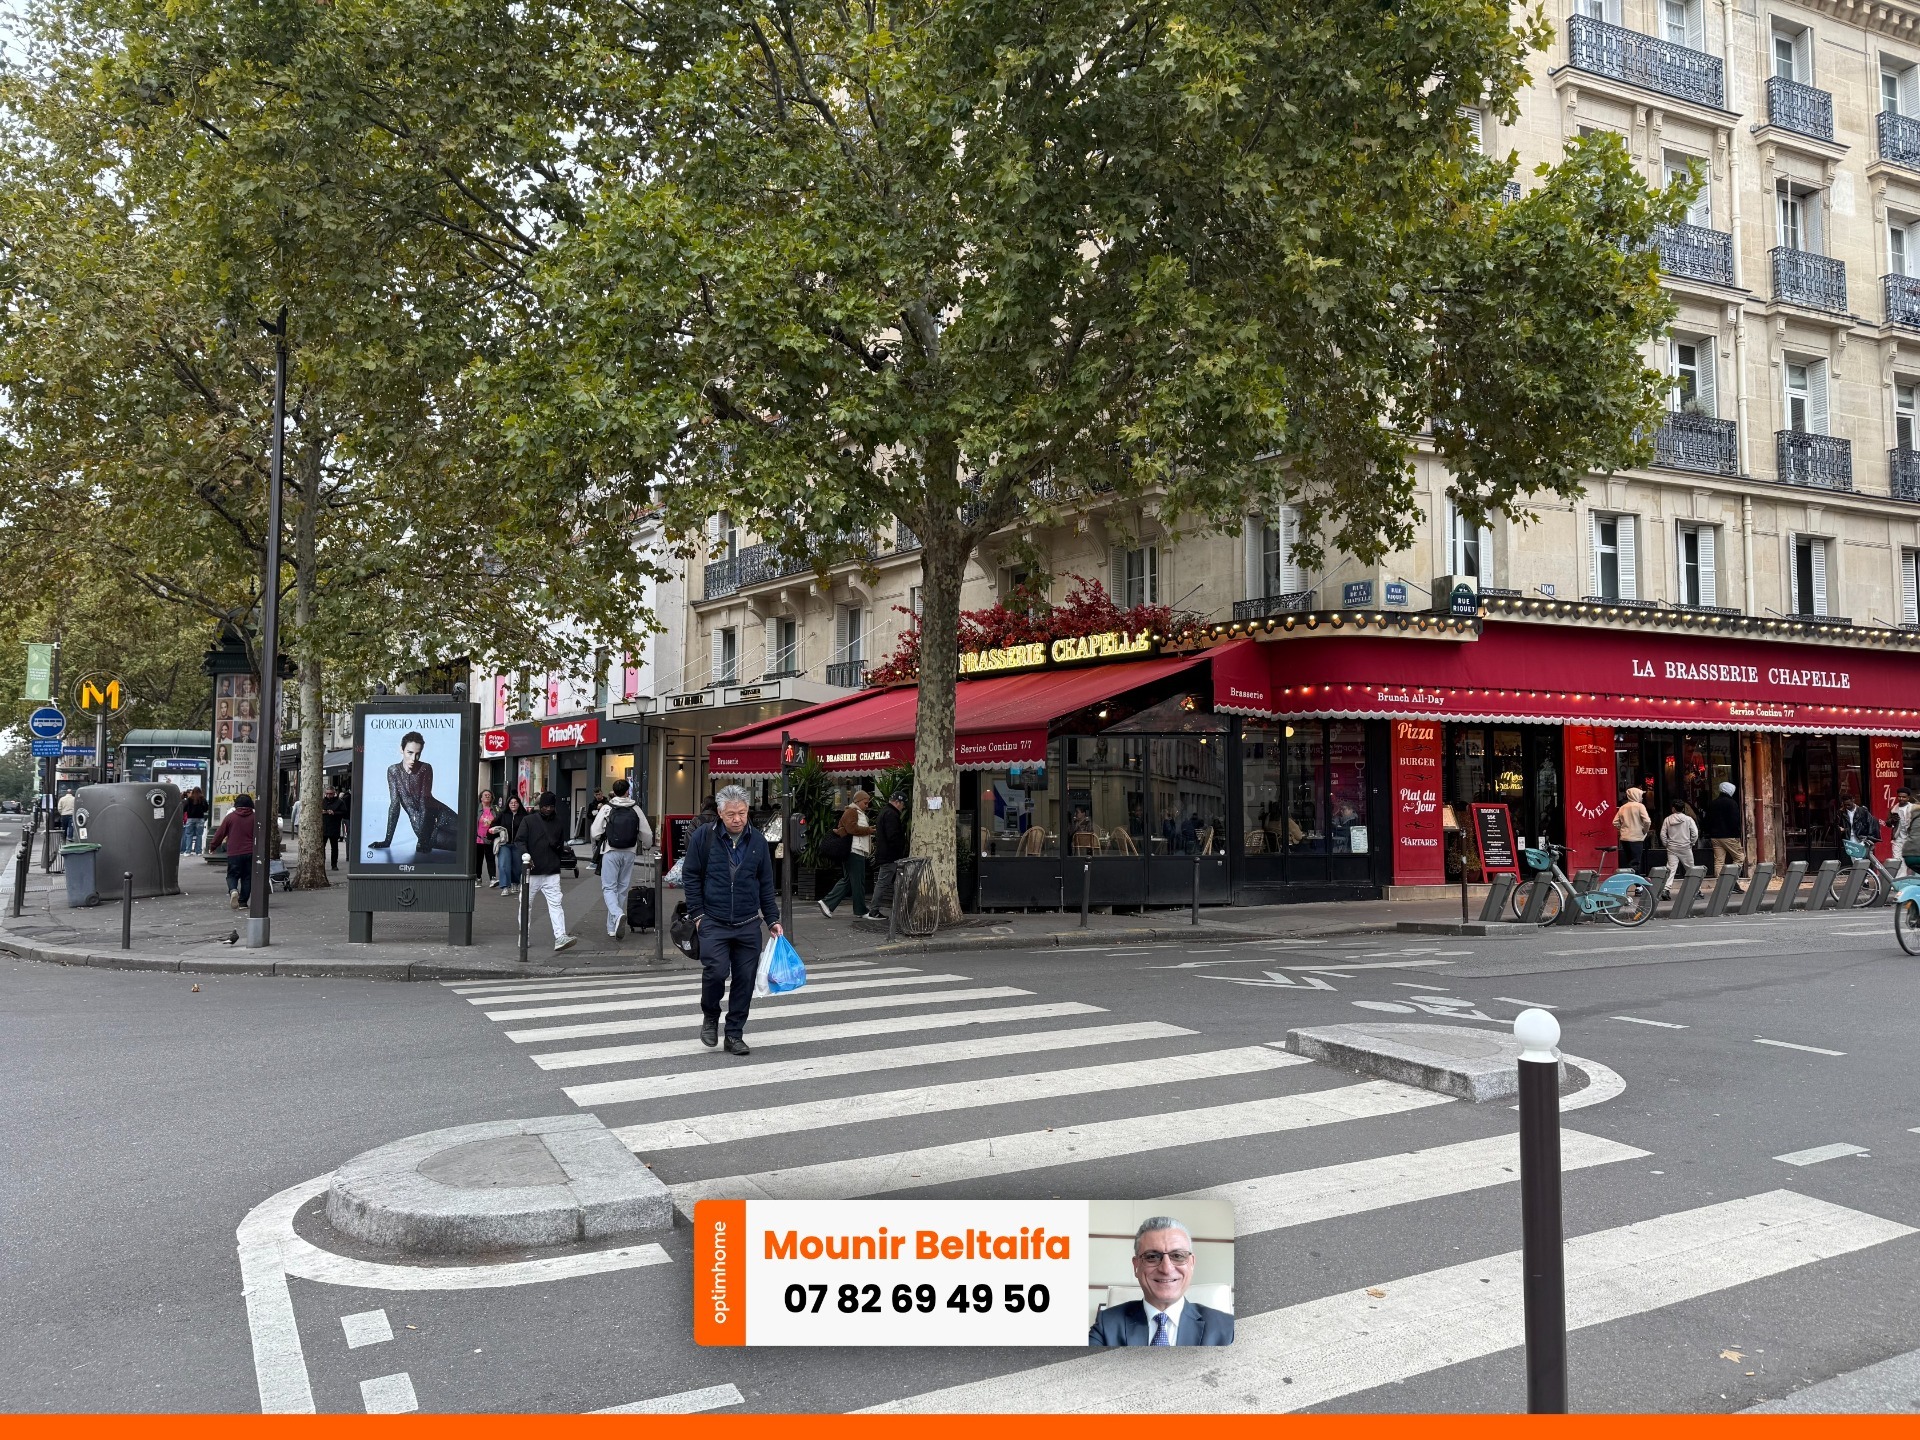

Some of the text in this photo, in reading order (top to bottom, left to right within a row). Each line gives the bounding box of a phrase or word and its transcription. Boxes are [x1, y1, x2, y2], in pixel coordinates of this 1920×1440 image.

[1541, 584, 1554, 595] 100
[1344, 595, 1372, 604] CHAPELLE
[1457, 597, 1470, 605] RUE
[1453, 605, 1475, 613] RIQUET
[958, 630, 1151, 674] BRASSERIE CHAPELLE
[1631, 659, 1850, 689] LA BRASSERIE CHAPELLE
[82, 679, 119, 710] M
[1230, 686, 1264, 700] Brasserie
[1377, 692, 1445, 706] Brunch All-Day
[1729, 706, 1795, 718] Service Continu 7/7
[371, 718, 454, 730] GIORGIO ARMANI
[1397, 722, 1434, 740] Pizza
[960, 740, 1032, 754] Service Continu 7/7
[717, 756, 739, 765] Brasserie
[826, 753, 857, 763] BRASSERIE
[859, 750, 891, 761] CHAPELLE
[1400, 757, 1436, 767] BURGER
[1875, 757, 1900, 769] Service
[216, 767, 231, 781] La
[1575, 765, 1609, 775] DÉJEUNER
[1875, 769, 1899, 778] Continu
[214, 781, 256, 795] Vérité
[1400, 788, 1436, 801] Plat du
[1415, 800, 1437, 815] Jour
[1574, 799, 1610, 820] DINER
[1400, 836, 1438, 847] TARTARES
